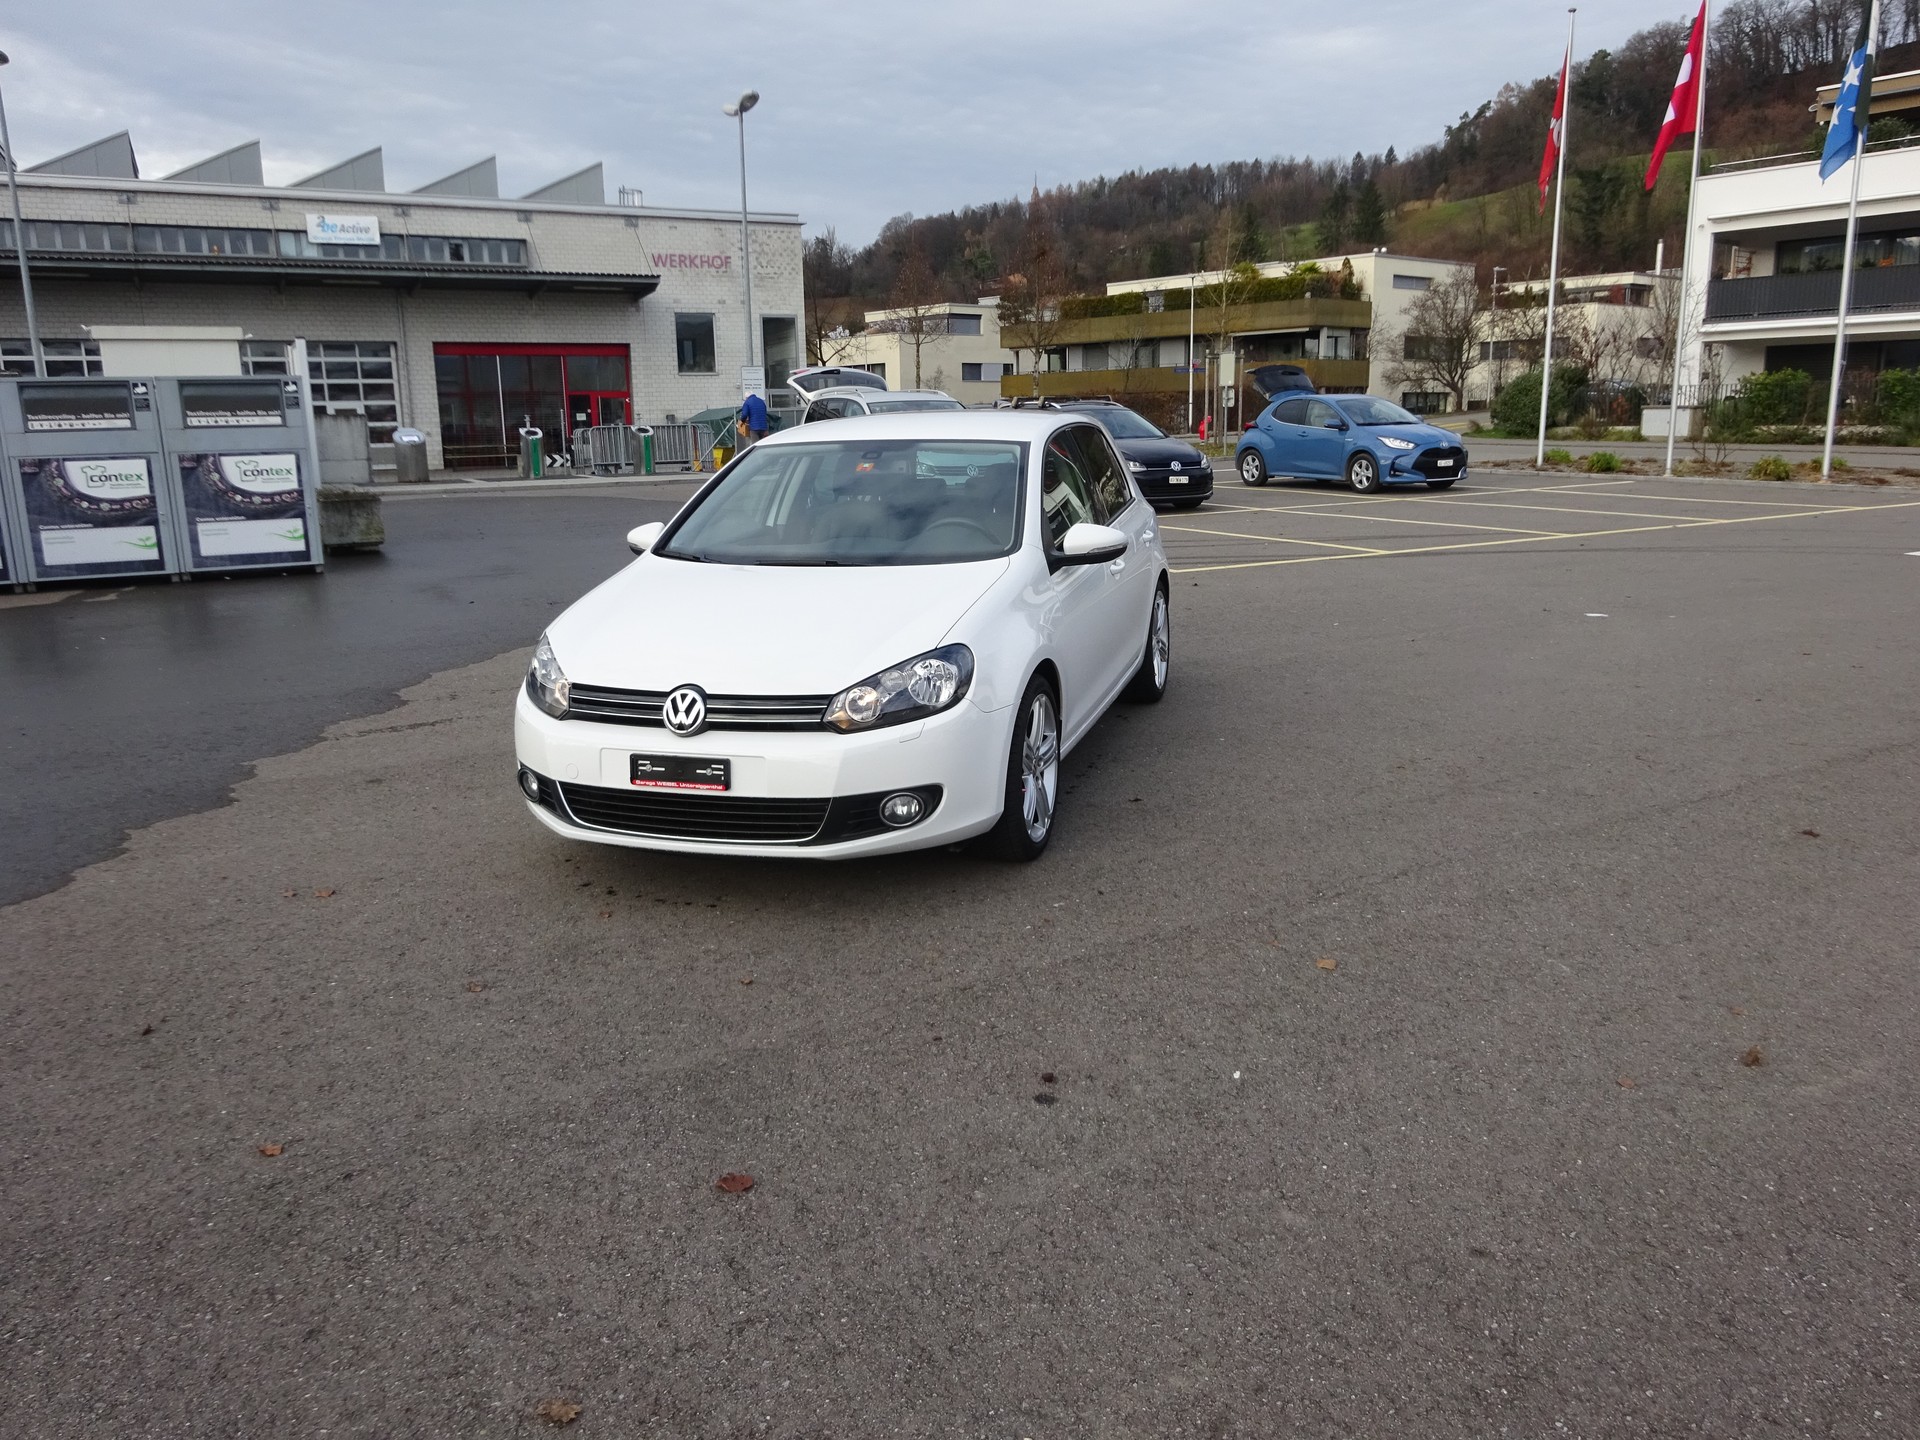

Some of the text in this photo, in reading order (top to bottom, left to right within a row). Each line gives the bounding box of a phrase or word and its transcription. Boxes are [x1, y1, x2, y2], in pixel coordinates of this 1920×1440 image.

[338, 222, 371, 234] Active
[651, 252, 732, 270] WERKHOF
[89, 471, 145, 484] contex
[243, 465, 294, 478] contex
[664, 690, 703, 734] VW
